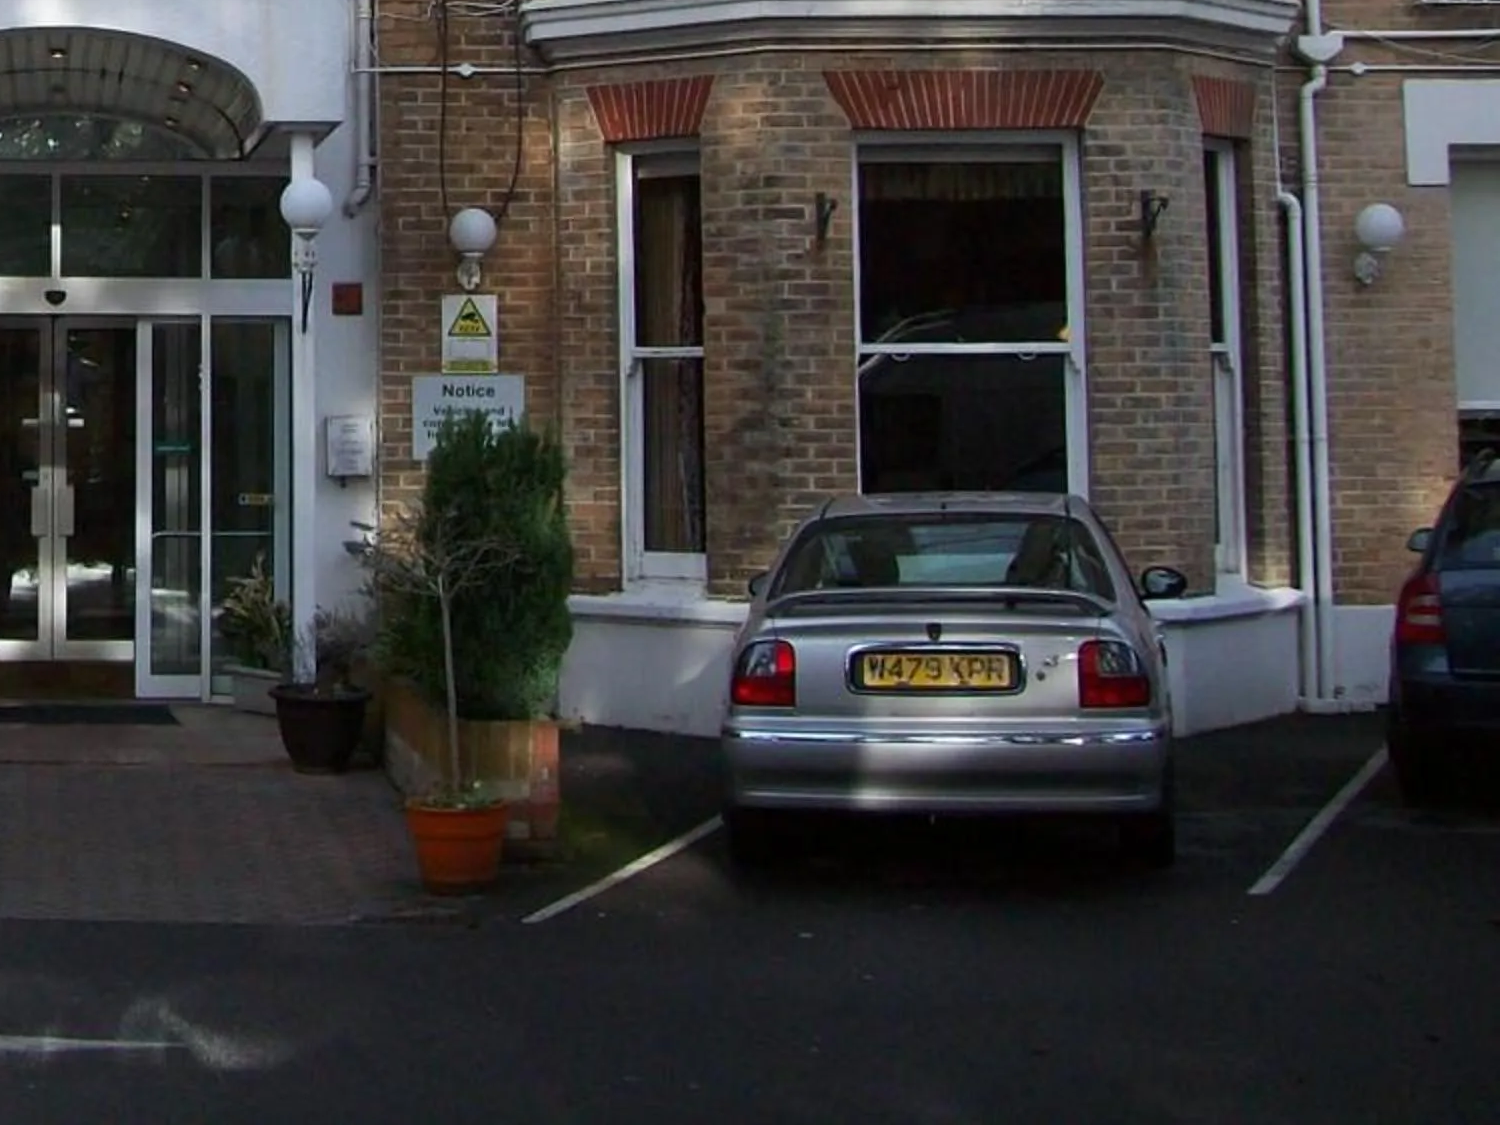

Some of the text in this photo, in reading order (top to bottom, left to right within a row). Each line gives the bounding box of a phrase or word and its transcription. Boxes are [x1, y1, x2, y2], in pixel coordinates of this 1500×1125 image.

[442, 384, 495, 397] Notice
[868, 657, 1003, 681] W479 KPR
